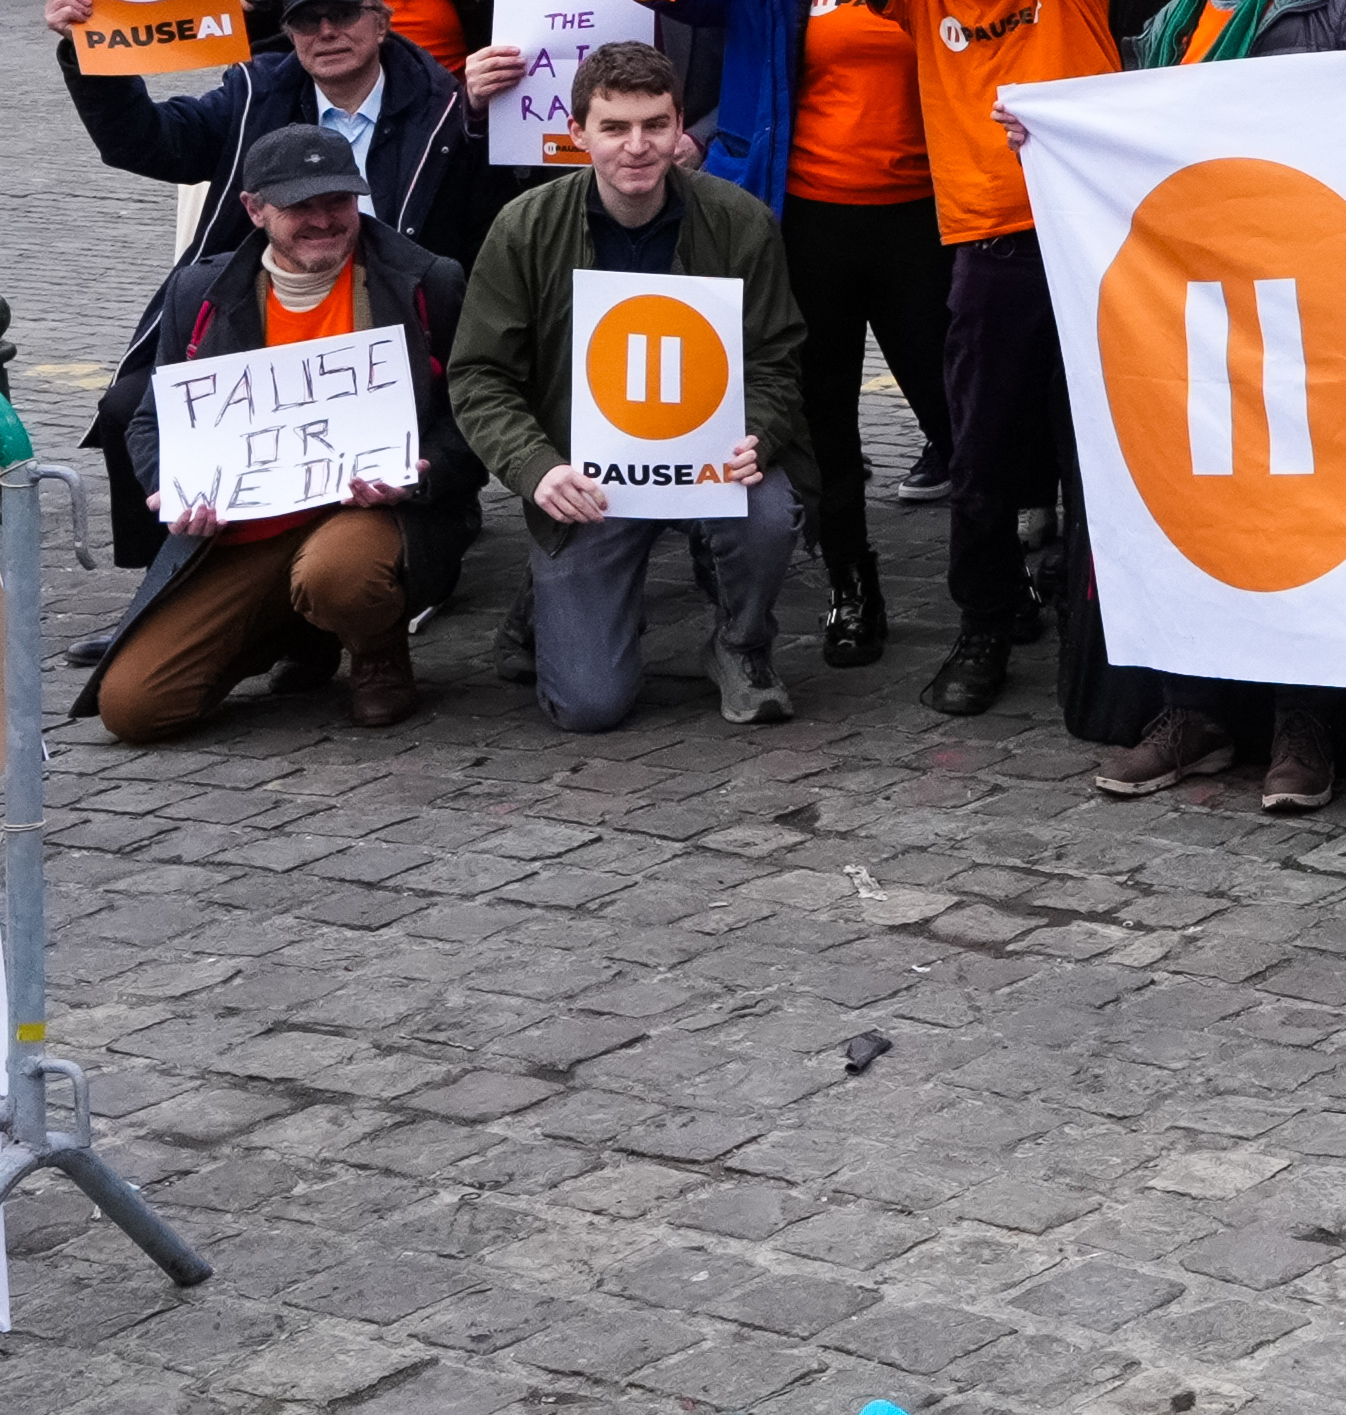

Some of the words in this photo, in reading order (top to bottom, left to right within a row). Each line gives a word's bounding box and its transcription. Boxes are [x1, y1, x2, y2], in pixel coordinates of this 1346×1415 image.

[84, 13, 233, 50] PAUSEAI
[543, 10, 596, 31] THE
[170, 339, 401, 429] PAUSE
[239, 418, 336, 469] OR
[172, 464, 283, 511] WE
[583, 461, 735, 487] PAUSEAI
